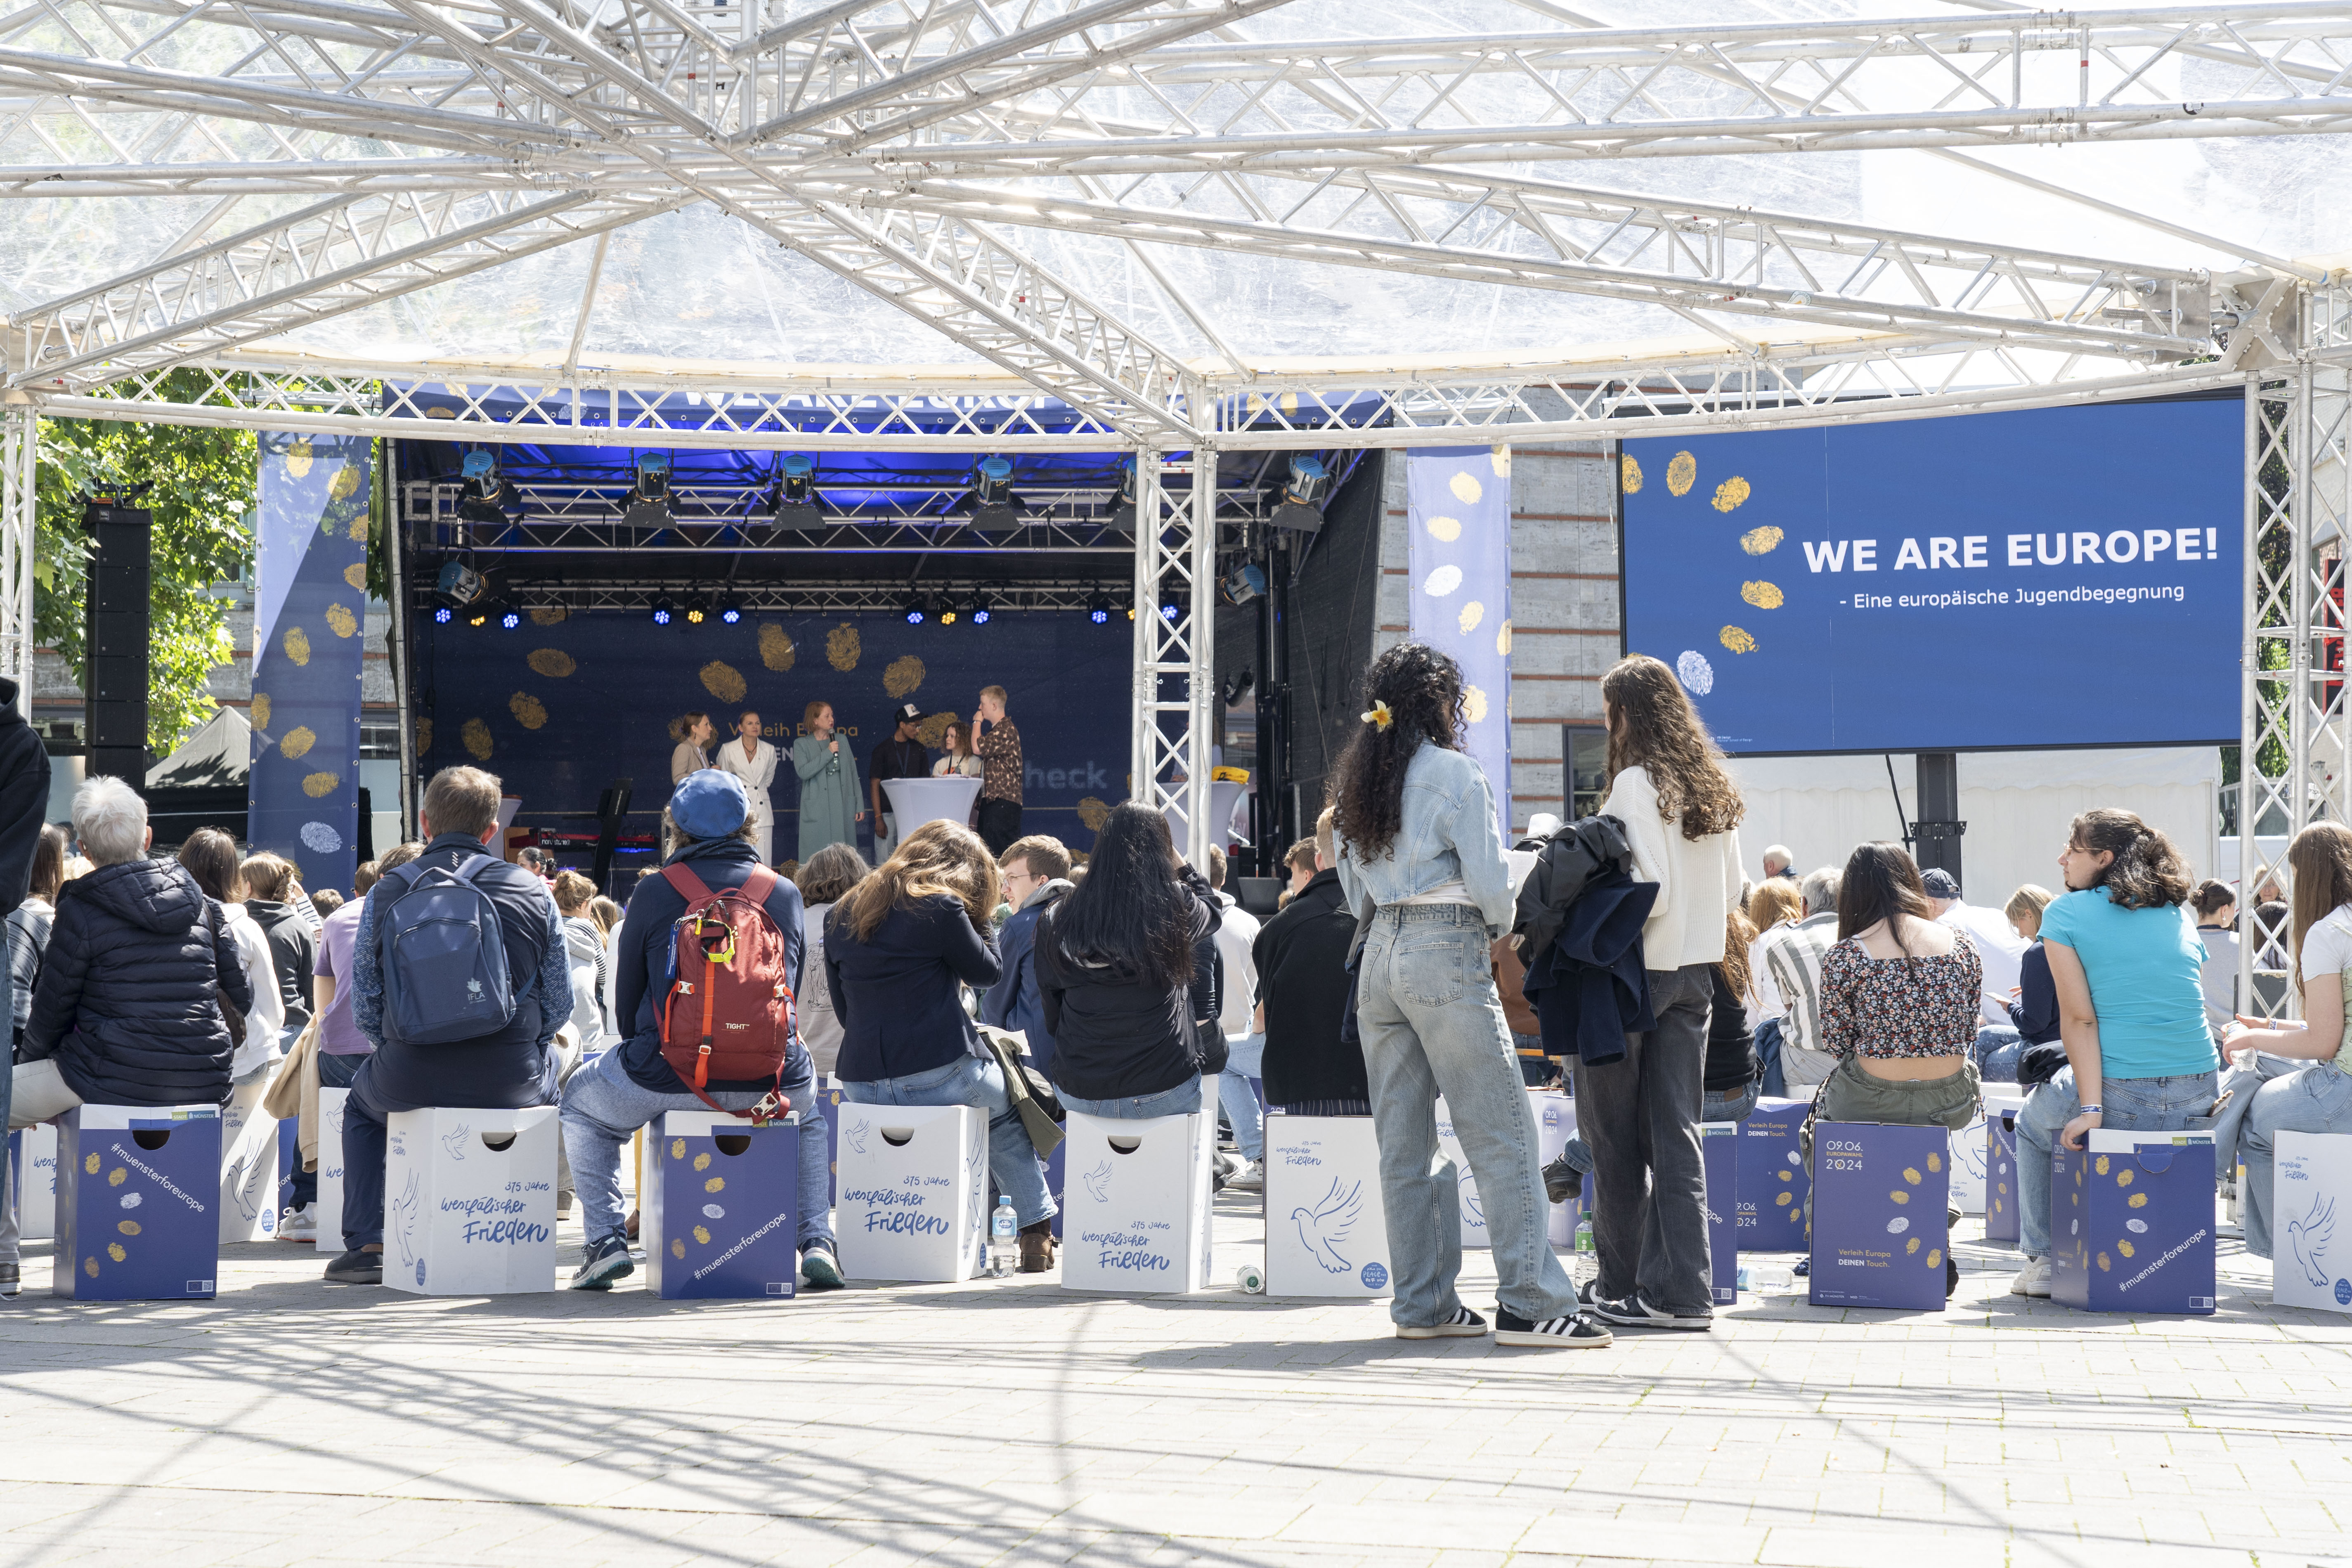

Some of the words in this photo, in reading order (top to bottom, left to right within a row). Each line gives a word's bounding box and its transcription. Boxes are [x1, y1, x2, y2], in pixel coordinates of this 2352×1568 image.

[1802, 539, 1877, 573] WE
[1893, 535, 1988, 570] ARE
[2007, 527, 2218, 566] EUROPE!
[1854, 593, 1893, 608] Eine
[1898, 589, 2009, 608] europäische
[2015, 585, 2185, 605] Jugendbegegnung
[729, 722, 790, 736] Vleih
[1023, 760, 1107, 789] heck
[468, 991, 485, 1000] IFLA
[1545, 1110, 1558, 1119] 09.06.
[1545, 1125, 1557, 1135] 2024
[1826, 1140, 1863, 1151] 09.06.
[1285, 1155, 1321, 1166] Frieden
[1826, 1159, 1863, 1171] 2024
[111, 1142, 204, 1212] #muensterforeurope
[903, 1175, 920, 1187] 375
[924, 1175, 950, 1187] Jahre
[505, 1181, 521, 1192] 375
[525, 1181, 550, 1192] Jahre
[845, 1187, 925, 1207] Westfälischer
[441, 1197, 527, 1217] Westfälischer
[1737, 1202, 1757, 1211] 9.06.
[864, 1210, 949, 1235] Frieden
[1131, 1221, 1145, 1230] 375
[1148, 1221, 1170, 1230] Jahre
[1737, 1217, 1757, 1227] 024
[462, 1218, 549, 1244] Frieden
[693, 1213, 787, 1280] #muensterforeurope
[1082, 1231, 1150, 1248] Westfälischer
[1098, 1250, 1170, 1271] Frieden
[1865, 1250, 1891, 1258] Europa
[2119, 1227, 2207, 1292] #muensterforeurope
